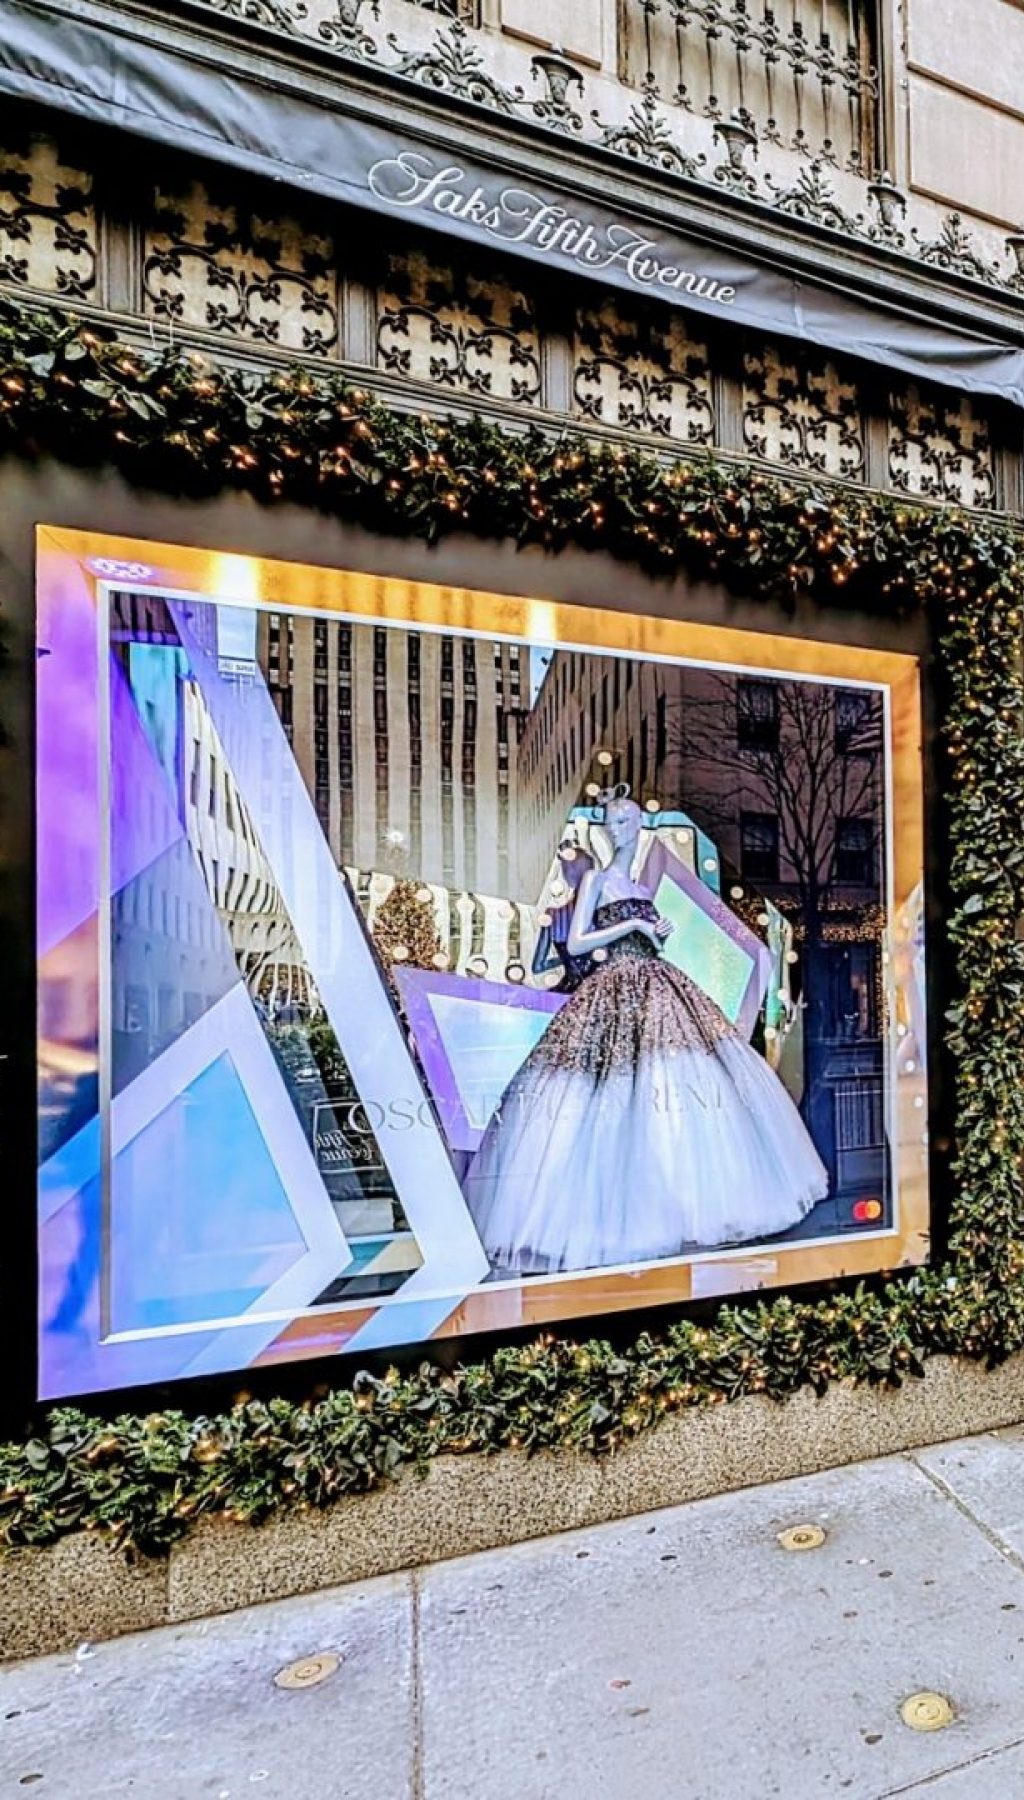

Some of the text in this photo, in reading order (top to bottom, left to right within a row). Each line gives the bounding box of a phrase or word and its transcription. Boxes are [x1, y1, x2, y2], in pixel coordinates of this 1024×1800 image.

[367, 151, 737, 304] Saks Fifth Avenue
